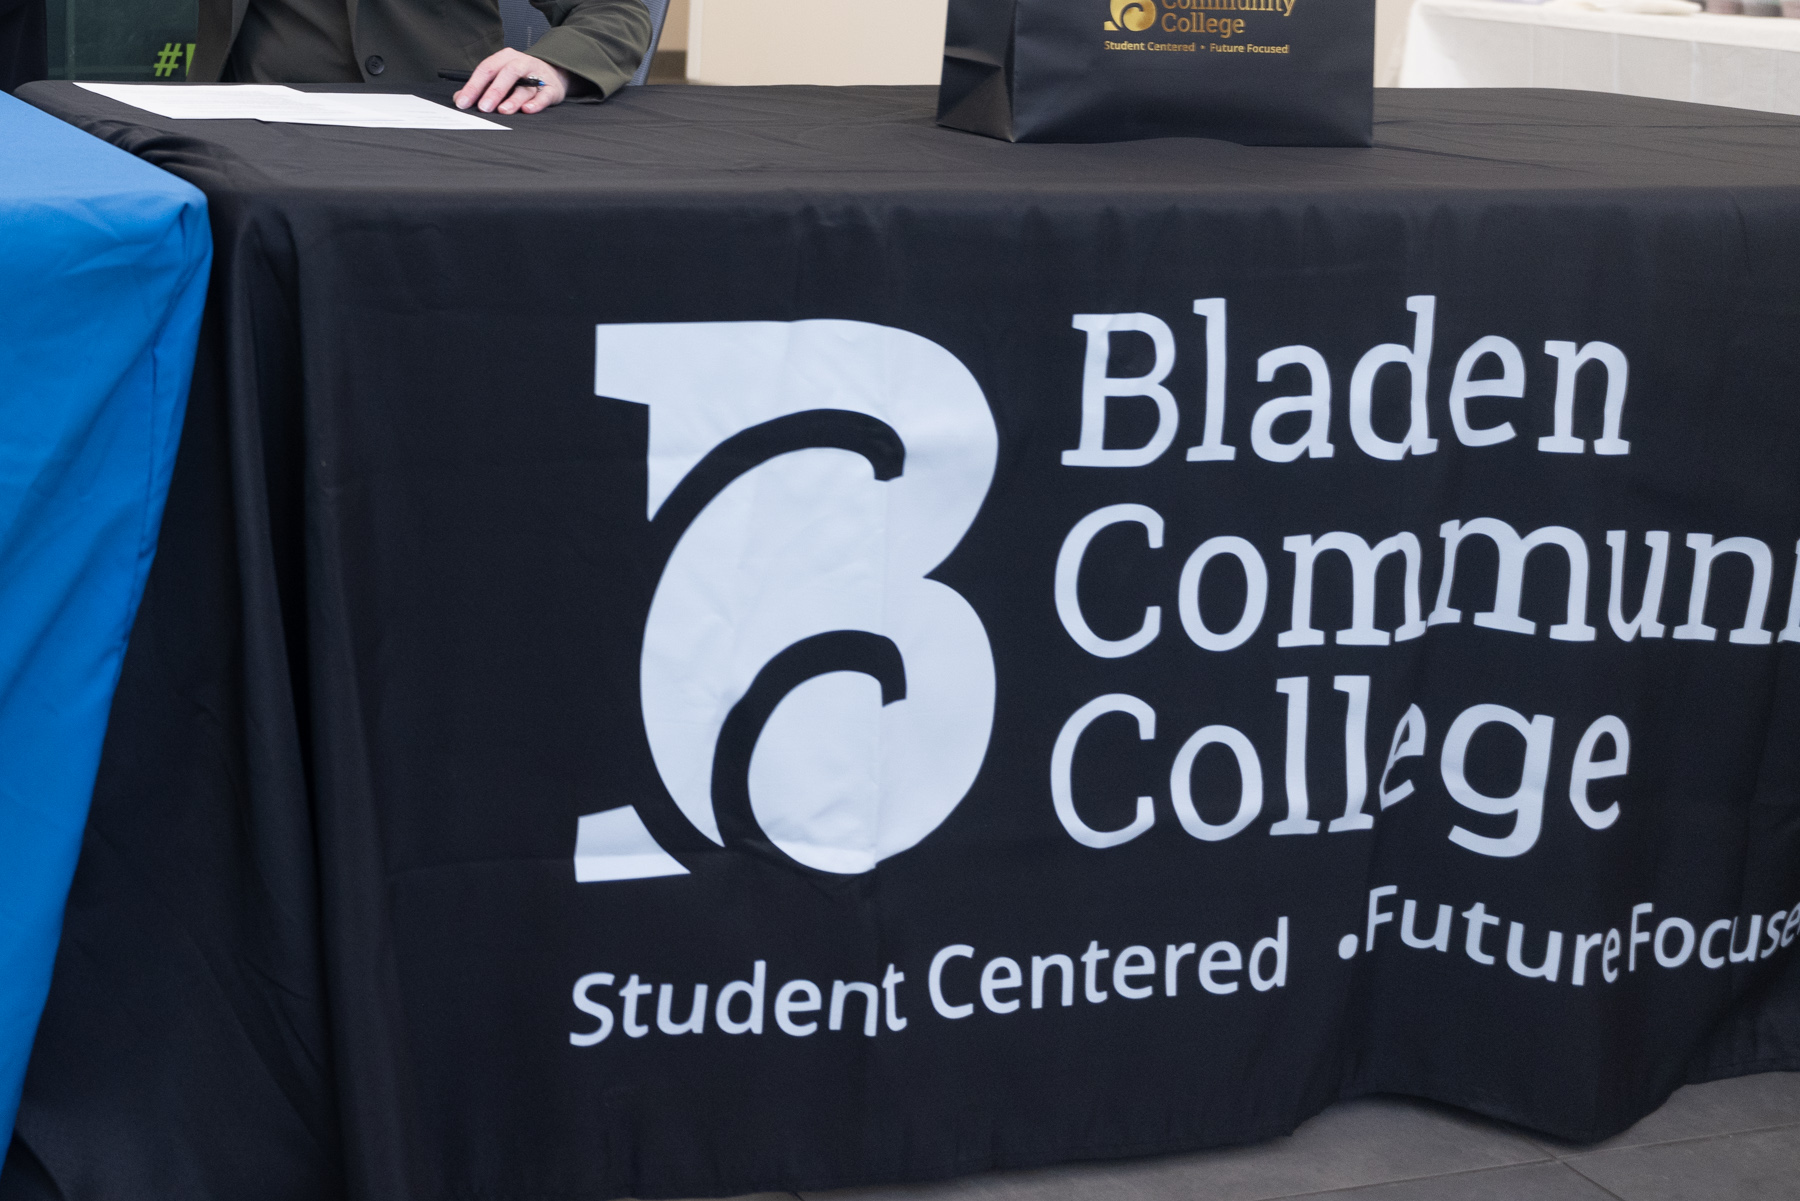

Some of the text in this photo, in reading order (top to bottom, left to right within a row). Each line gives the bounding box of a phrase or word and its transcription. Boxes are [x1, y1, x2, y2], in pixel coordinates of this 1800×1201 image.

[1103, 40, 1290, 54] Student Centered Future Focused
[1161, 11, 1246, 39] College
[1061, 294, 1631, 468] Bladen
[1050, 674, 1631, 858] College
[569, 884, 1800, 1048] Student Centered Future Focuse
